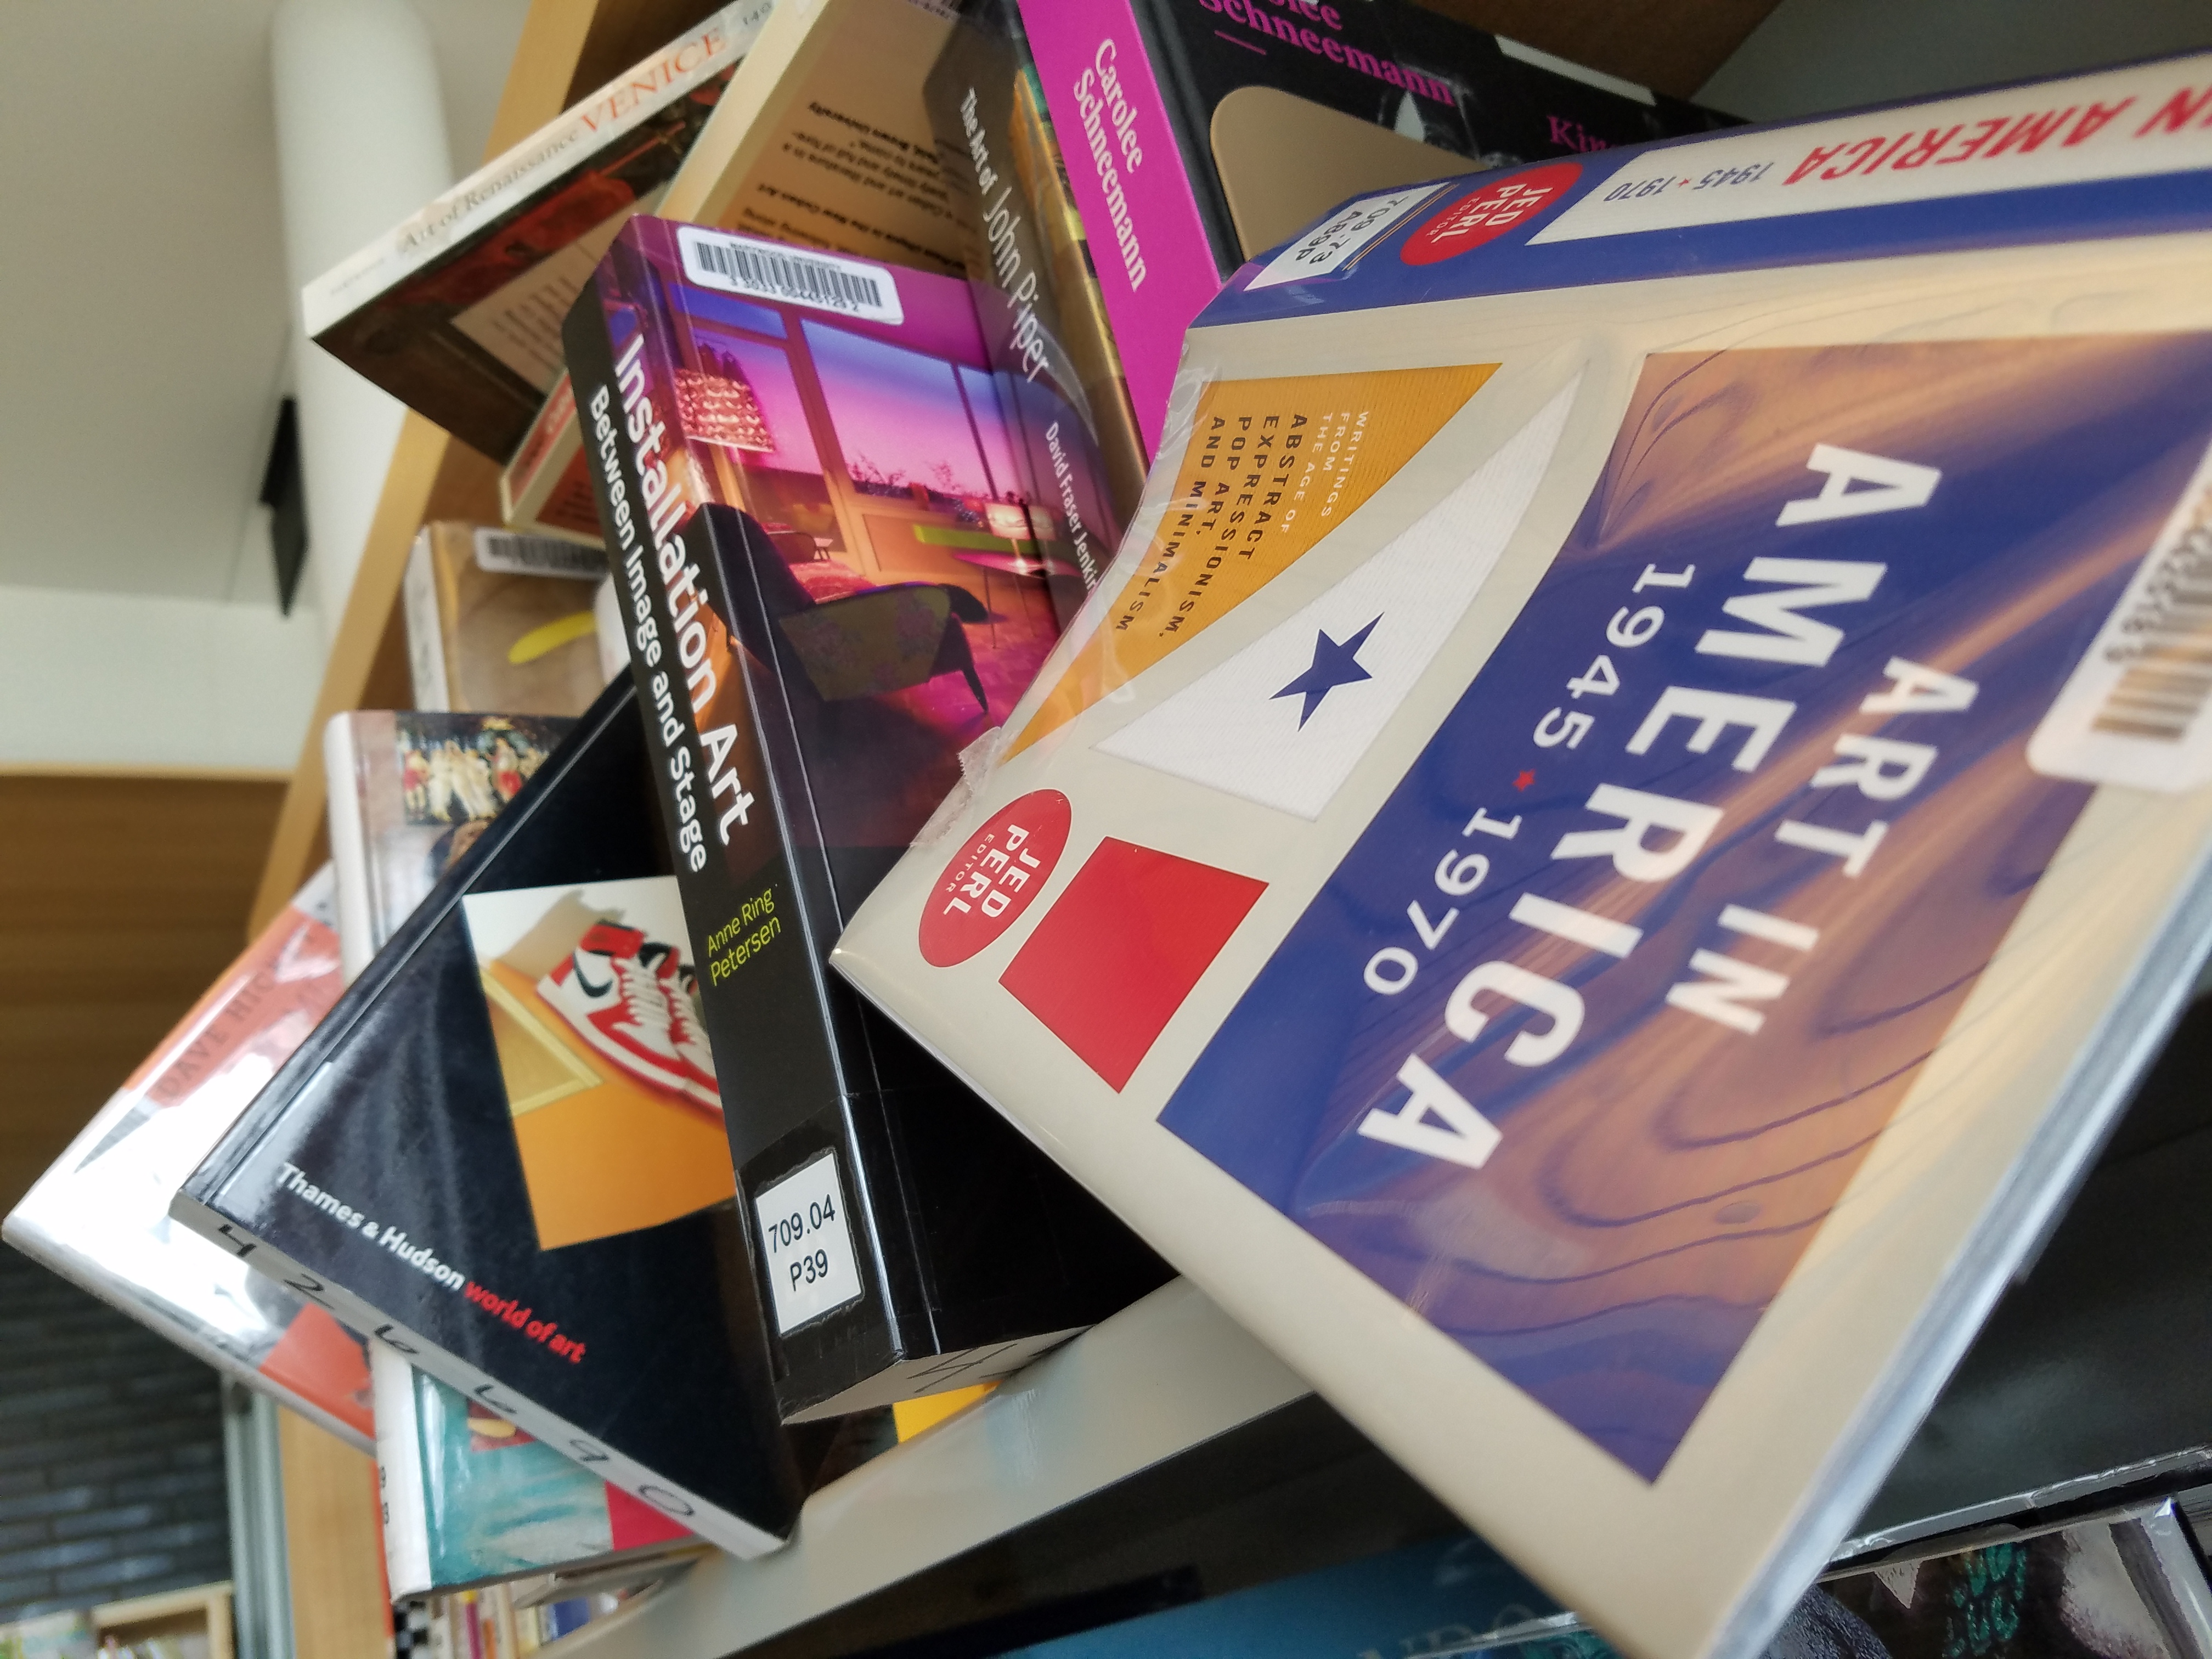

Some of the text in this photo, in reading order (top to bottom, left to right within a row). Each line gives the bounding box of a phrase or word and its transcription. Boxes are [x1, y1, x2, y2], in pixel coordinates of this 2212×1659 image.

[439, 199, 462, 230] of
[465, 129, 580, 208] Renaissance
[580, 26, 726, 132] VENICE
[1095, 38, 1143, 173] Carolee
[1547, 115, 1617, 152] Kin
[1604, 82, 2212, 202] N AMERICA 1945 1970
[960, 88, 1049, 383] The Art of John Piper
[1074, 67, 1148, 292] Schneemann
[1310, 196, 1409, 264] 709.73
[1426, 196, 1481, 236] EDITOR
[1431, 183, 1527, 244] PERL
[1485, 187, 1554, 227] JED
[1227, 417, 1252, 470] POP
[1238, 414, 1308, 560] ABSTRACT
[1280, 412, 1334, 534] THE AGE OF
[1321, 410, 1369, 517] WRITINGS
[1322, 412, 1350, 472] FROM
[1046, 420, 1098, 590] David Fraser Jenkin
[1115, 416, 1226, 630] AND MINIMALISM
[590, 385, 707, 872] Between Image and Stage
[614, 333, 755, 846] Installation Art
[1357, 442, 1942, 1170] AMERICA
[1363, 562, 1695, 995] 1945 1970
[943, 825, 1030, 916] PERL
[945, 834, 995, 893] EDITOR
[980, 848, 1041, 918] JED
[1666, 656, 1979, 1034] ART IN
[708, 888, 775, 958] Anne Ring
[710, 916, 781, 986] Petersen
[276, 1162, 586, 1364] Thames & Hudson world of art
[768, 1194, 836, 1253] 709.04
[790, 1248, 828, 1292] P39
